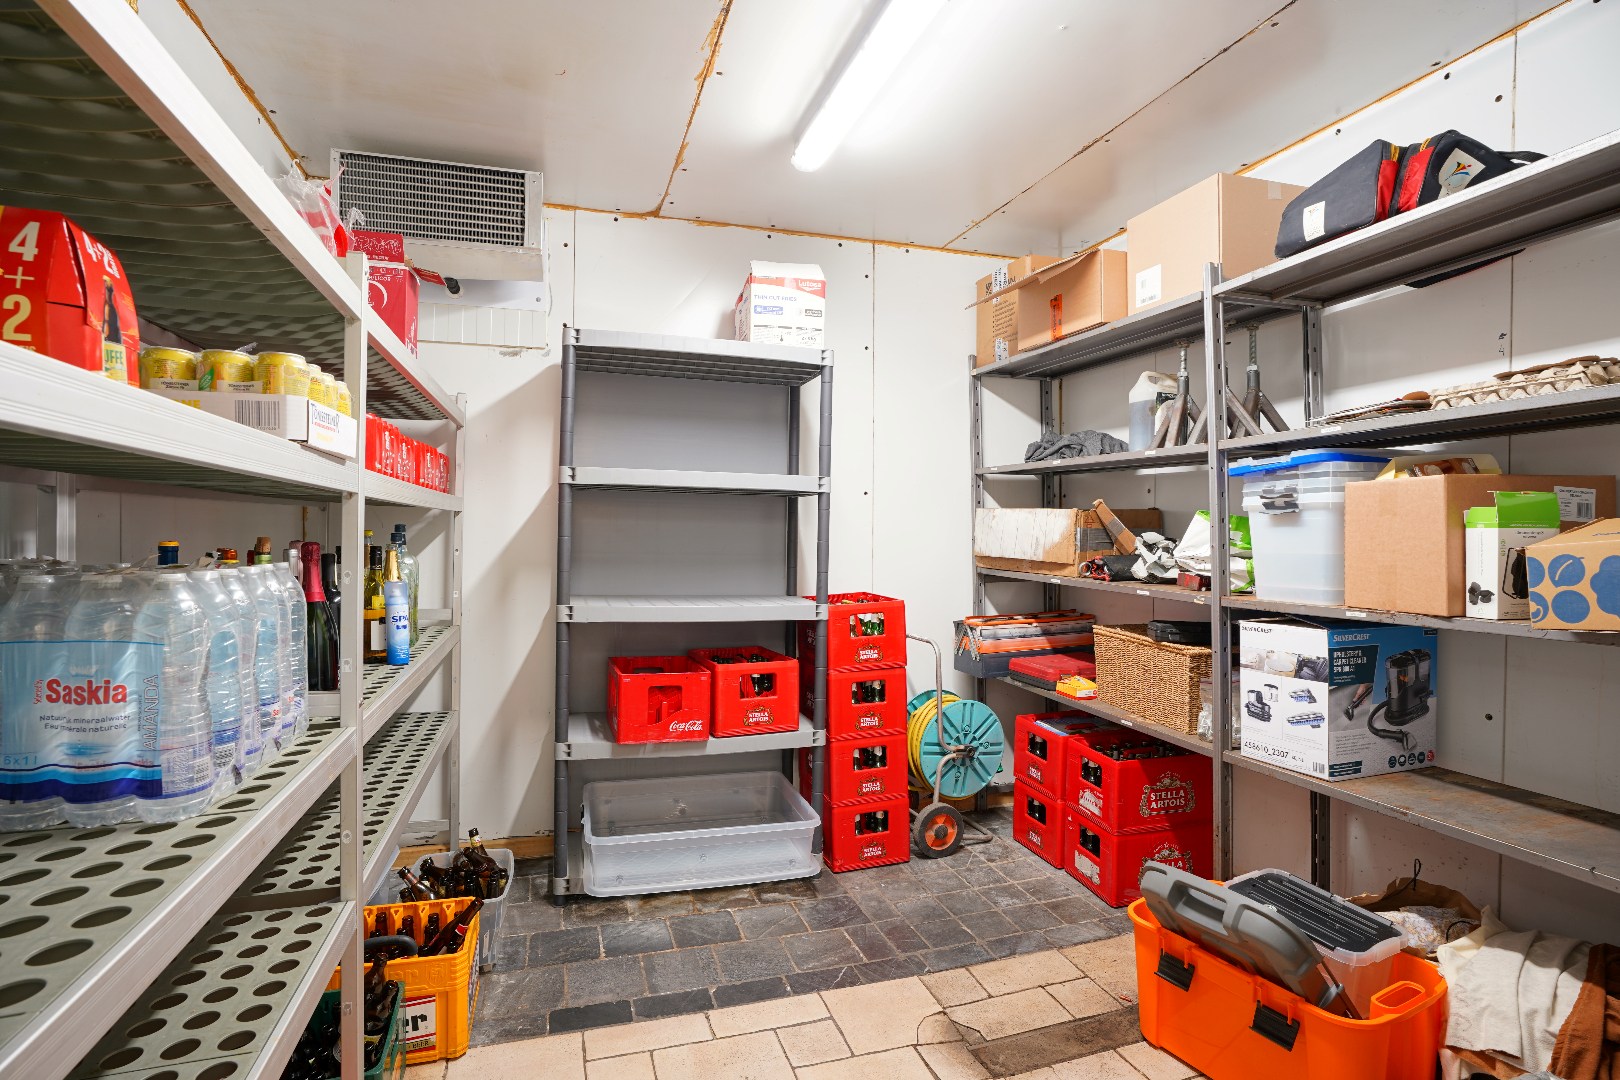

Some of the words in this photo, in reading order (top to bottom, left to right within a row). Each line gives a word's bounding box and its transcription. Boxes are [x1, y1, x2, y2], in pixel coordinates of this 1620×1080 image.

[8, 221, 41, 262] 4
[2, 294, 33, 342] 2
[45, 678, 128, 706] Saskia
[143, 674, 159, 750] AMANDA
[669, 719, 703, 732] Coca-Cola
[1150, 789, 1185, 801] STELLA
[1150, 798, 1186, 809] ARTOIS
